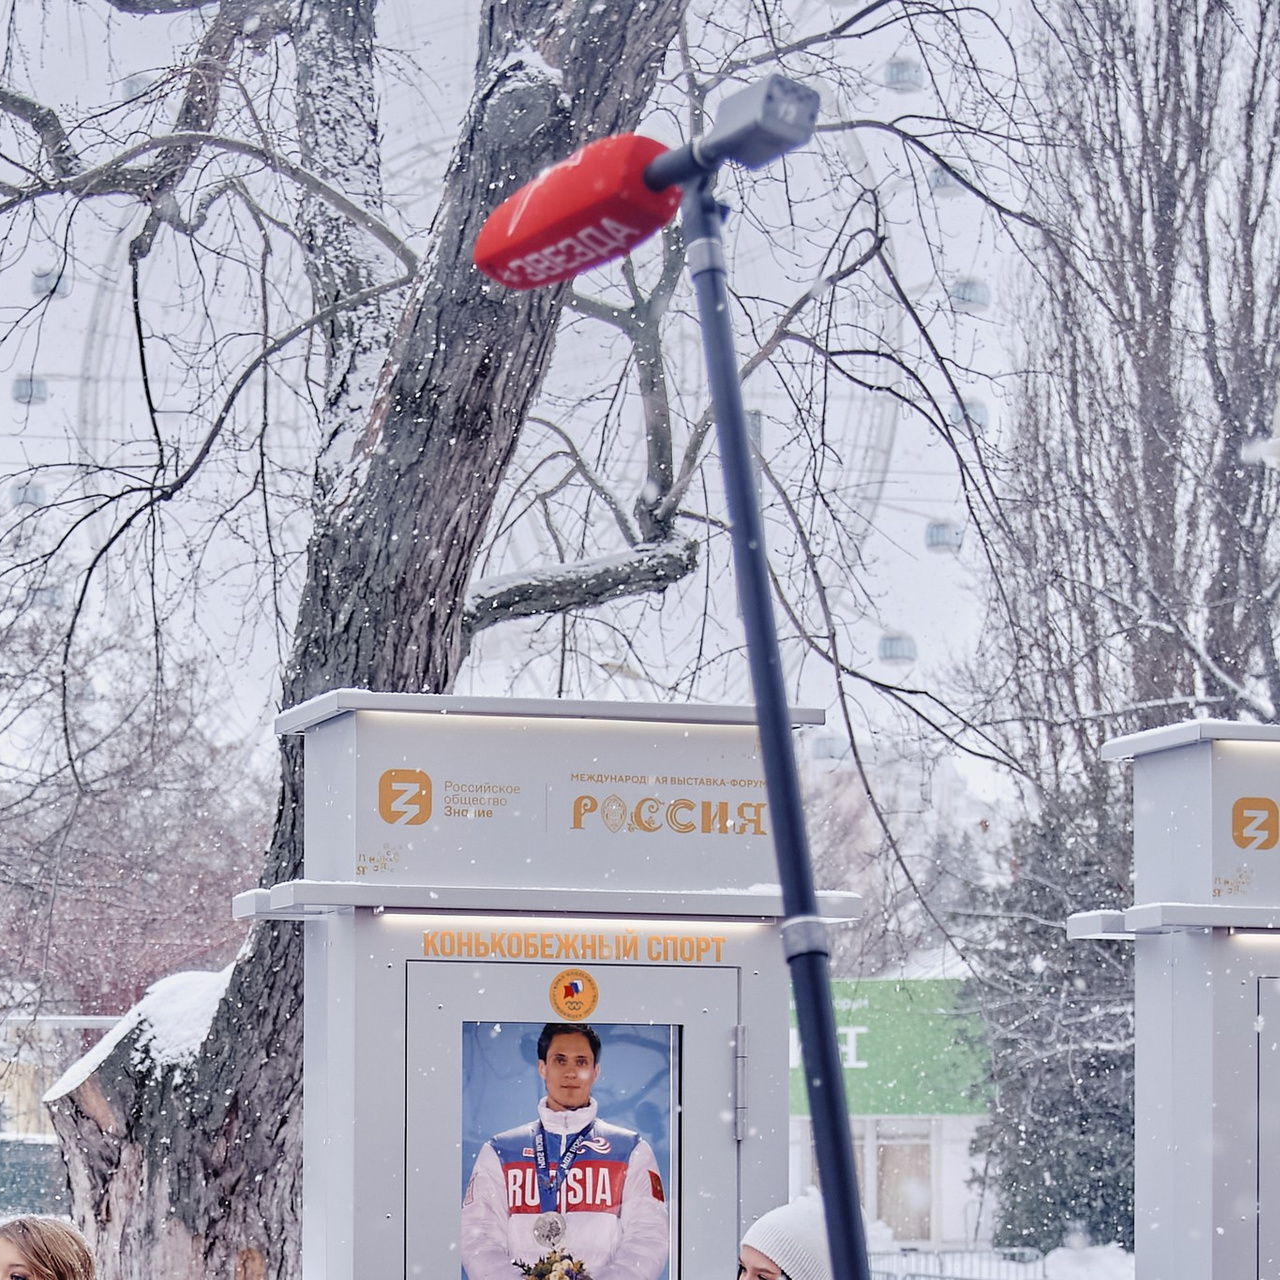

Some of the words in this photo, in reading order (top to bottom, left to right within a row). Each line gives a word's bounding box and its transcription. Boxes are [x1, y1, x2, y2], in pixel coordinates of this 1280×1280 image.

[507, 216, 641, 282] ЗВЕЗДА
[443, 793, 508, 807] общество
[444, 780, 521, 794] Российское
[570, 794, 770, 836] РОССИЯ
[422, 929, 639, 961] КОНЬКОБЕЖНЫЙ
[647, 934, 727, 963] СПОРТ
[507, 1167, 612, 1207] RUSIA
